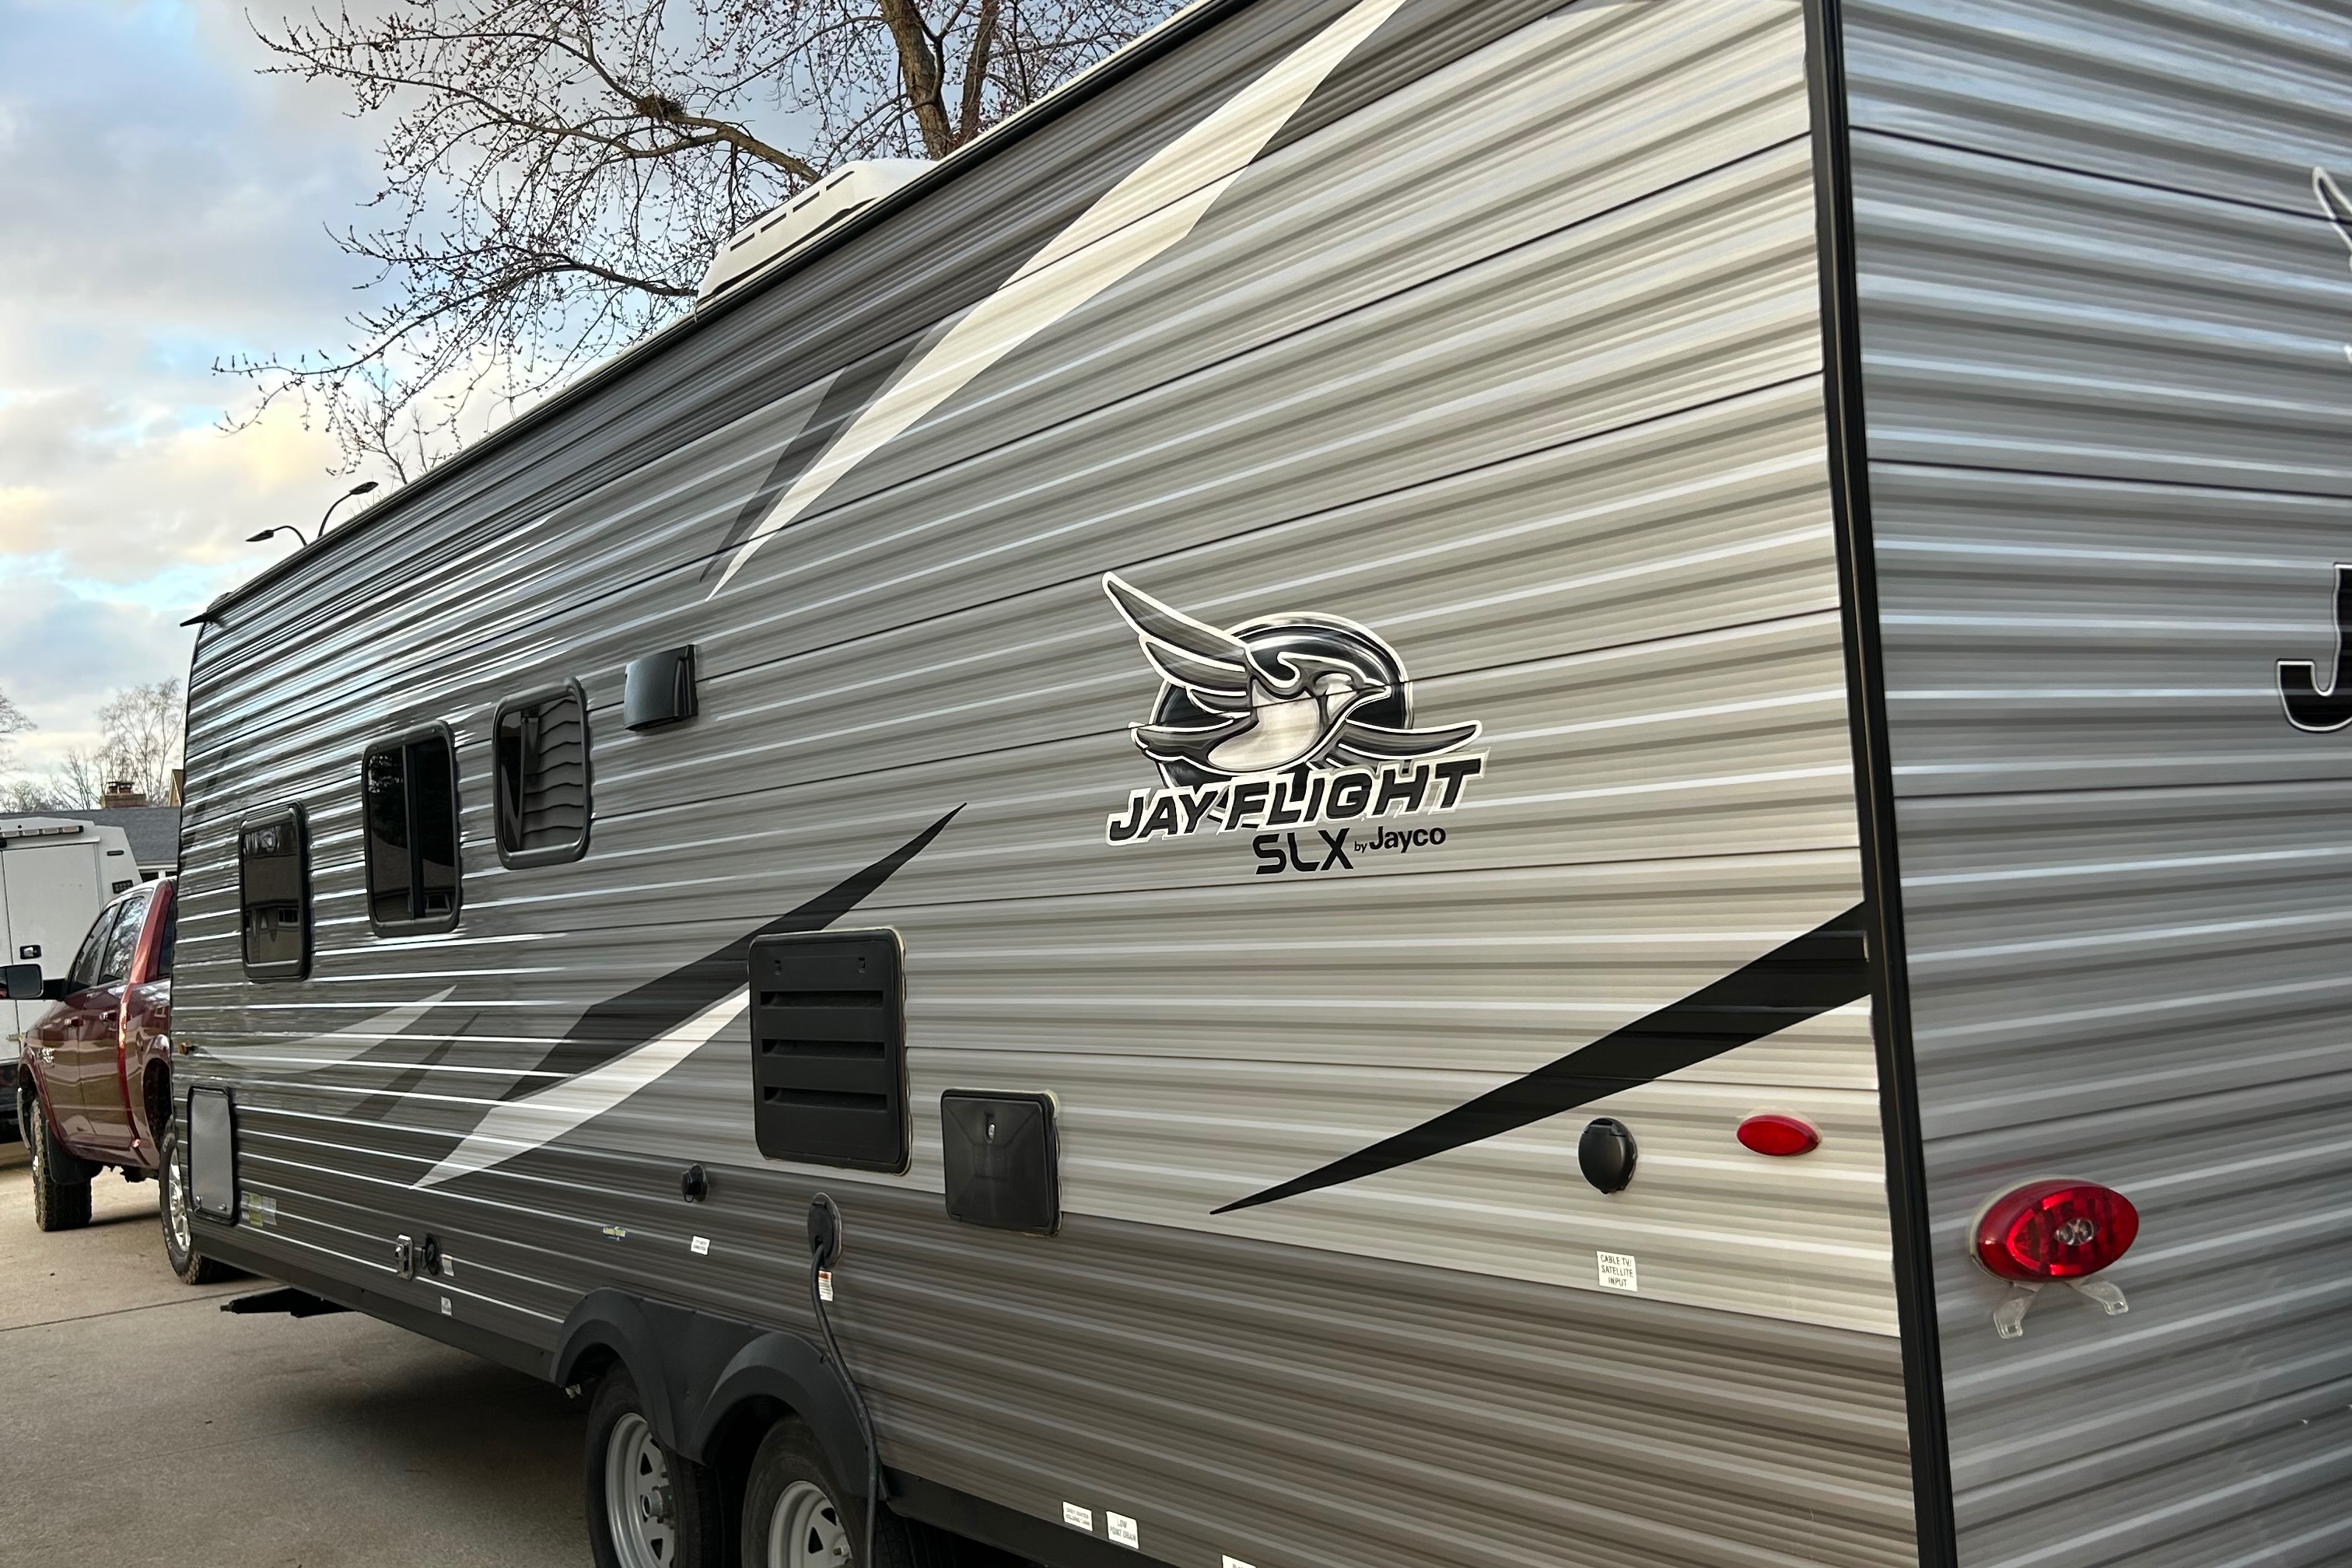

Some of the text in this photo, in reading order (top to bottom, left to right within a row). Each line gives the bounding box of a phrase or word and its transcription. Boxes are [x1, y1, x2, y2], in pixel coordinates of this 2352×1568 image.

[1253, 825, 1447, 875] SLX by Jayco
[1600, 1254, 1620, 1265] CABLE
[1601, 1265, 1633, 1278] SATELLITE
[1608, 1276, 1626, 1287] INPUT
